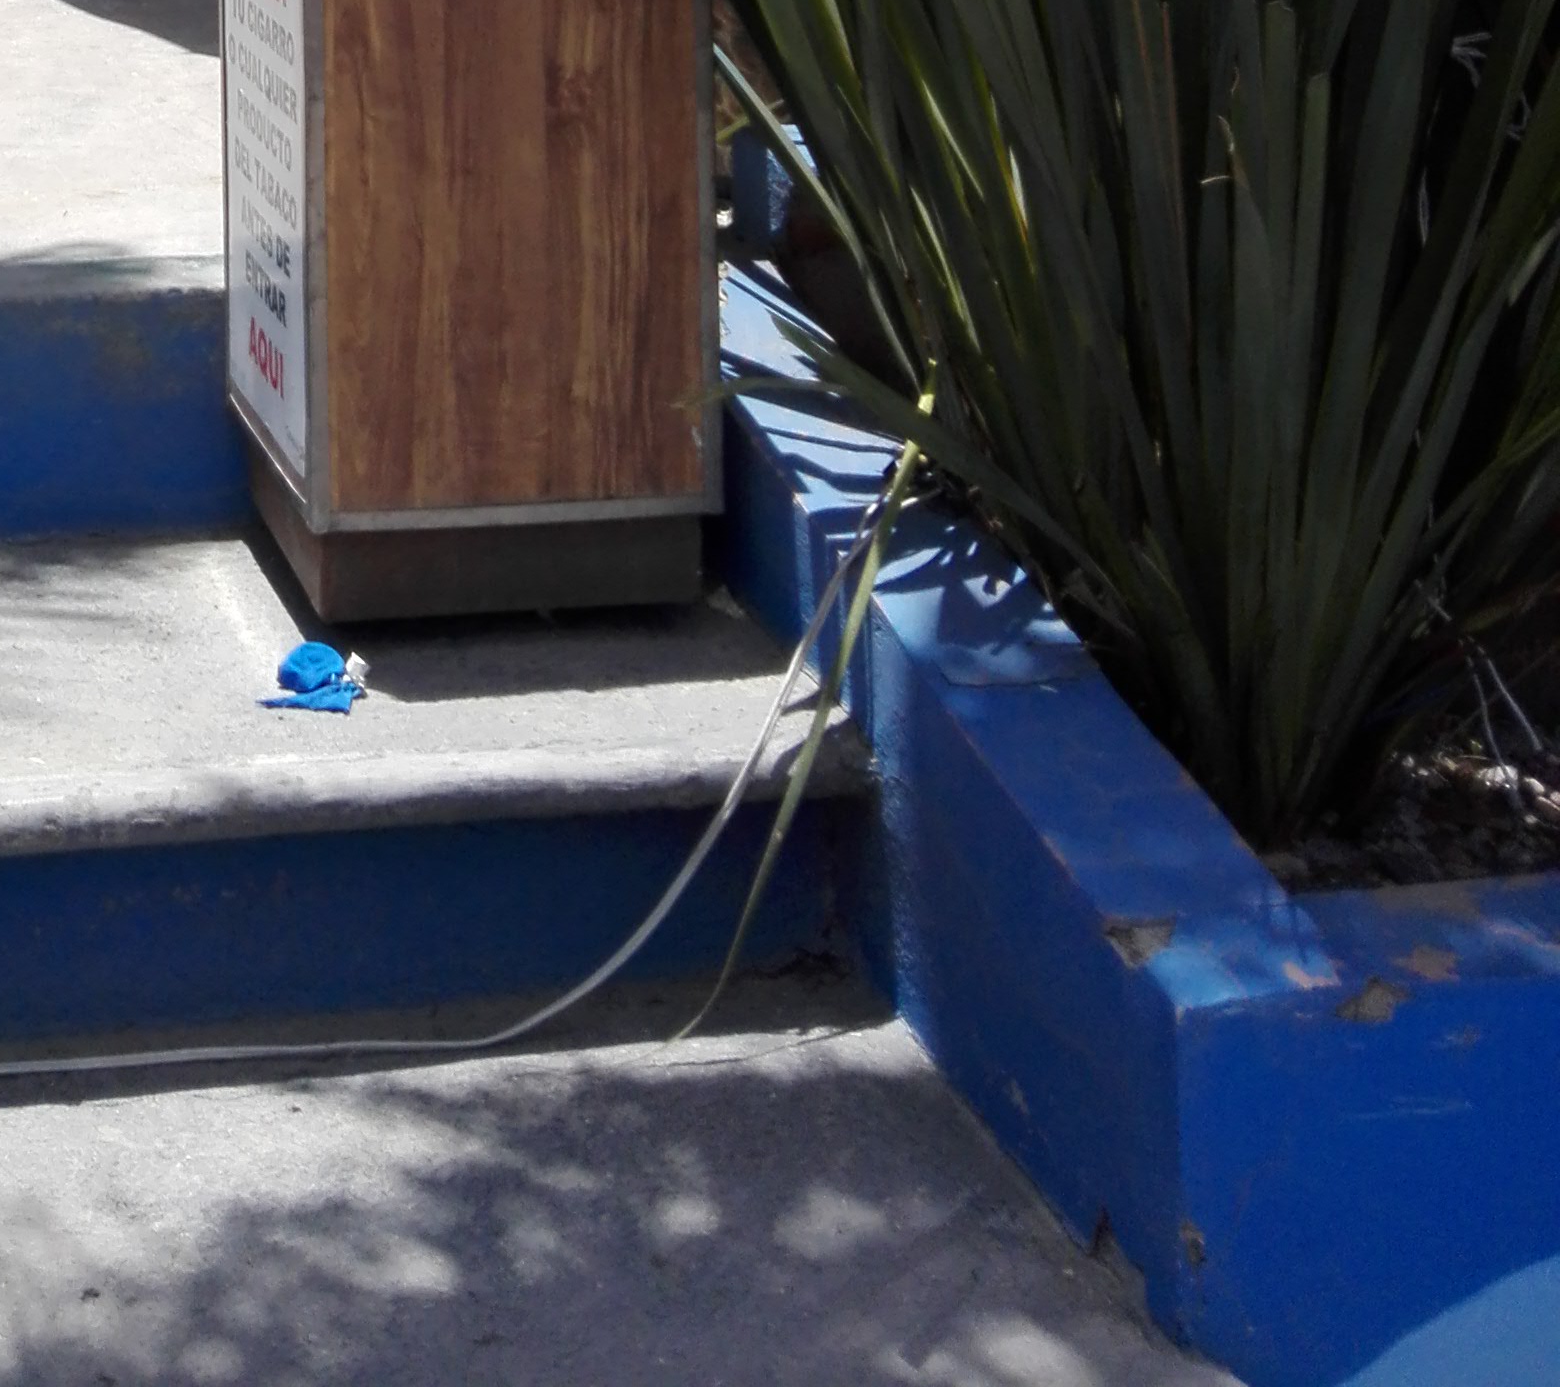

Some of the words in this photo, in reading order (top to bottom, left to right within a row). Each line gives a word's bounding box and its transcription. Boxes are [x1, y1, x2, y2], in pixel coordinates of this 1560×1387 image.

[247, 0, 295, 66] CIGARRO
[228, 32, 236, 65] O
[238, 41, 298, 125] CUALQUIER
[237, 88, 292, 172] PRODUCTO
[235, 135, 253, 183] DEL
[254, 157, 297, 231] TABACO
[242, 194, 273, 258] ANTES
[276, 234, 291, 279] DE
[245, 248, 287, 328] ENTRAR
[248, 315, 285, 401] AQUI
